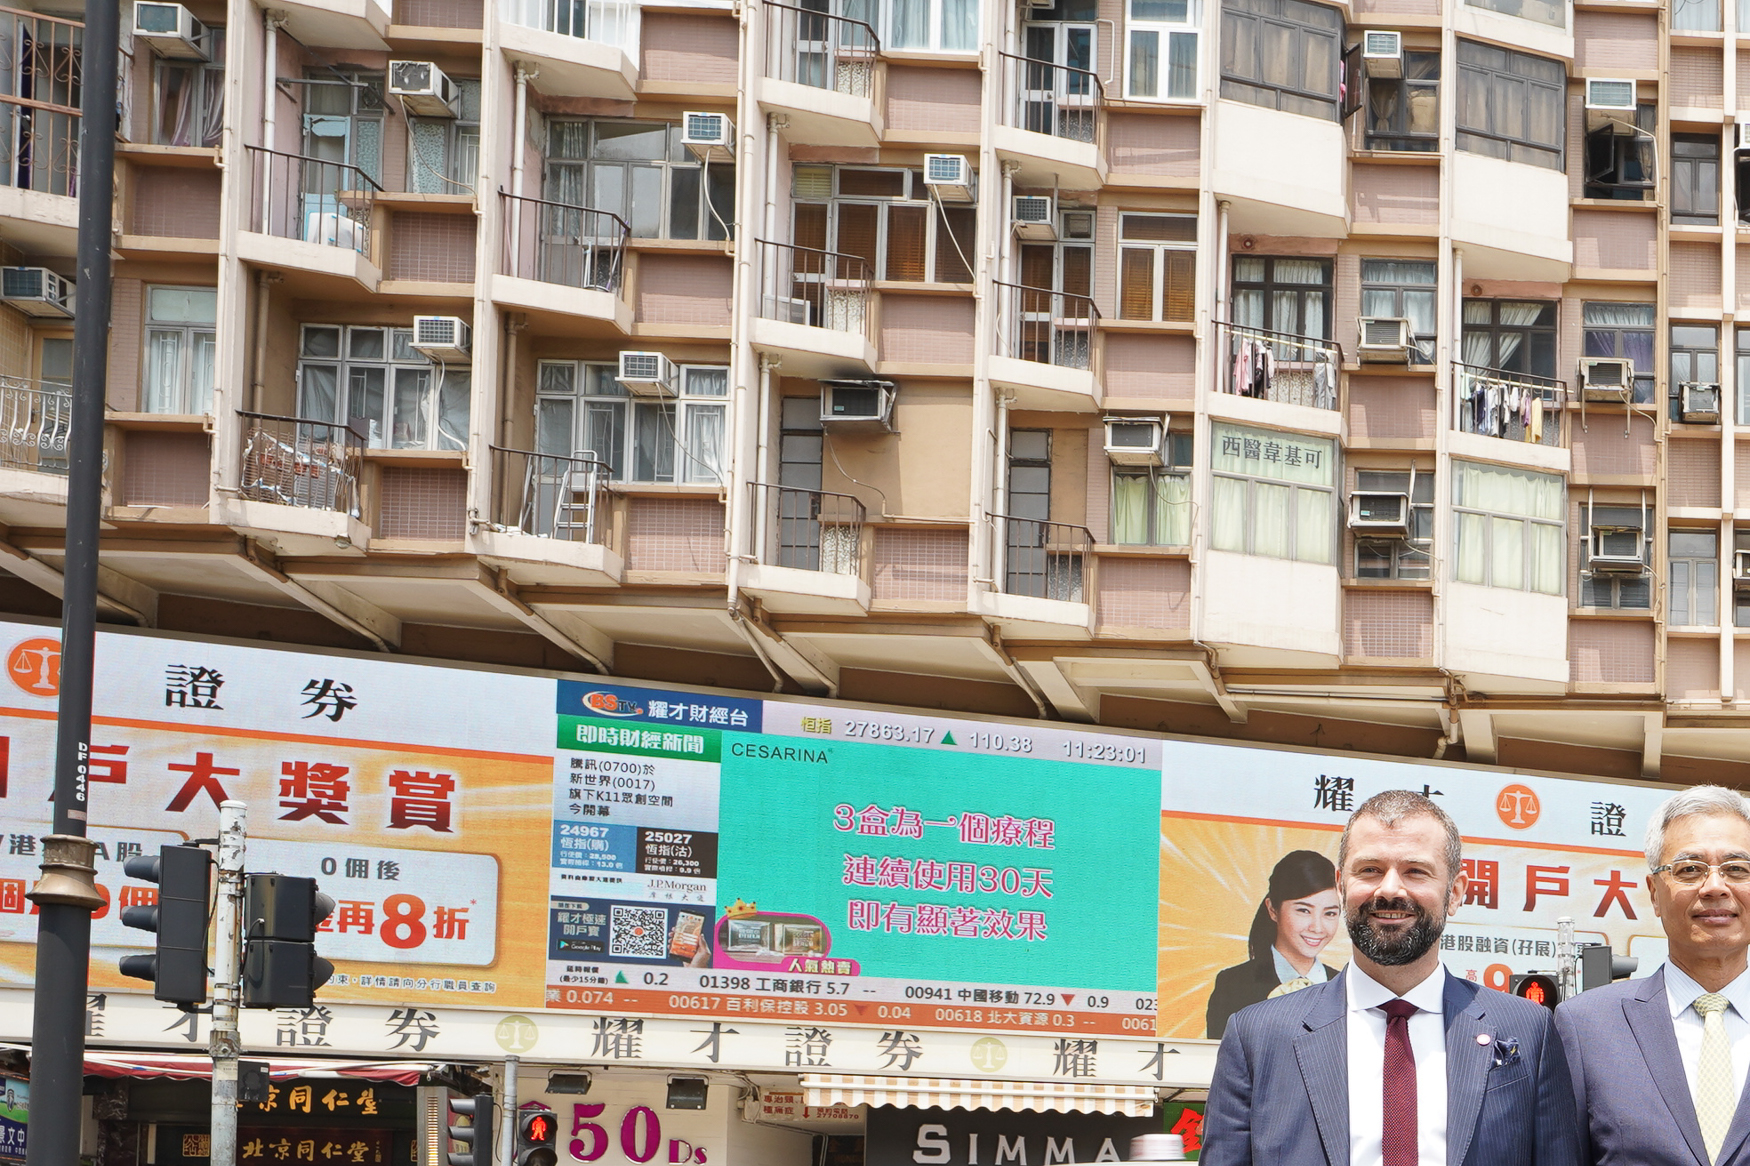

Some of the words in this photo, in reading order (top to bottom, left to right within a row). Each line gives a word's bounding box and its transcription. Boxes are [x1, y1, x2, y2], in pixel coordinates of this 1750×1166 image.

[1221, 434, 1323, 470] 西醫韋基可
[165, 663, 358, 723] 證券
[648, 699, 748, 728] 耀才財經台
[575, 724, 705, 755] 即時財經新聞
[731, 741, 829, 765] CESARINA
[844, 719, 936, 744] 27863.17
[969, 731, 1033, 753] 110.38
[1062, 740, 1147, 764] 11:23:01
[0, 736, 457, 833] 戶大獎賞
[570, 772, 656, 792] 新世界(0017)
[569, 803, 610, 817] 今開幕
[833, 803, 1056, 850] 3盒為一個療程
[560, 824, 609, 838] 24967
[645, 831, 692, 845] 25027
[842, 853, 1054, 899] 連續使用30天
[847, 899, 1048, 942] 即有顯著效果
[788, 958, 853, 975] 人氣熱賣
[566, 989, 614, 1005] 0.074
[668, 994, 720, 1010] 00617
[726, 998, 809, 1016] 百利保控股
[814, 1002, 848, 1016] 3.05
[877, 1005, 911, 1020] 0.04
[935, 1008, 982, 1022] 00618
[987, 1010, 1049, 1027] 北大資源
[1052, 1014, 1075, 1027] 0.3
[643, 972, 669, 986] 0.2
[699, 975, 751, 990] 01398
[755, 977, 822, 994] 工商銀行
[826, 983, 850, 995] 5.7
[905, 986, 952, 1000] 00941
[957, 987, 1019, 1005] 中國移動
[1024, 991, 1055, 1006] 72.9
[1087, 995, 1109, 1008] 0.9
[591, 1016, 923, 1071] 耀才證券
[236, 1085, 379, 1115] 京同仁堂
[242, 1137, 369, 1163] 北京同仁堂
